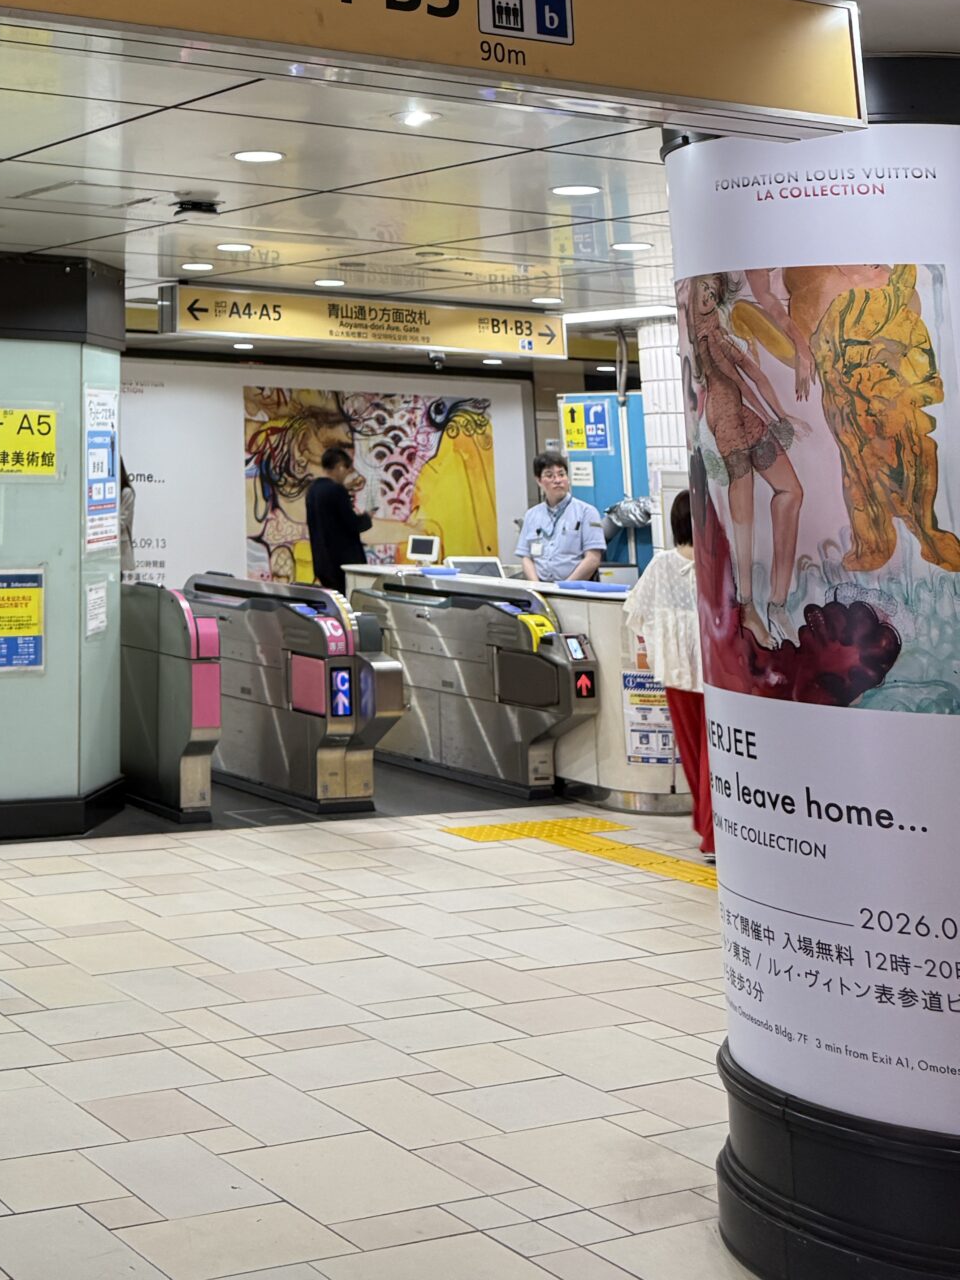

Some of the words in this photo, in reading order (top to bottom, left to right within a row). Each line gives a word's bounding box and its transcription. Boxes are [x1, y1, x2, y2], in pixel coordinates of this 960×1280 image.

[480, 40, 527, 67] 90m
[715, 170, 798, 192] FONDATION
[806, 168, 856, 182] LOUIS
[861, 166, 937, 180] VUITTON
[756, 189, 774, 201] LA
[779, 183, 885, 199] COLLECTION
[328, 304, 430, 326] 青山通り方面改札
[339, 321, 384, 330] Aoyama-dori
[16, 413, 52, 436] A5
[315, 619, 344, 637] IC
[332, 671, 350, 691] IC
[715, 773, 732, 798] me
[736, 771, 796, 815] leave
[805, 786, 928, 833] home...
[724, 818, 738, 837] THE
[740, 824, 827, 860] COLLECTION
[860, 907, 958, 940] 2026.0
[782, 932, 855, 967] 入場無料
[738, 1005, 773, 1032] Omotesando
[775, 1024, 795, 1043] Bldg.
[797, 1032, 809, 1045] 7F
[815, 1038, 822, 1049] 3
[825, 1042, 841, 1055] min
[845, 1045, 869, 1061] from
[872, 1051, 892, 1065] Exit
[895, 1056, 914, 1070] A1,
[917, 1059, 960, 1076] Omotes
